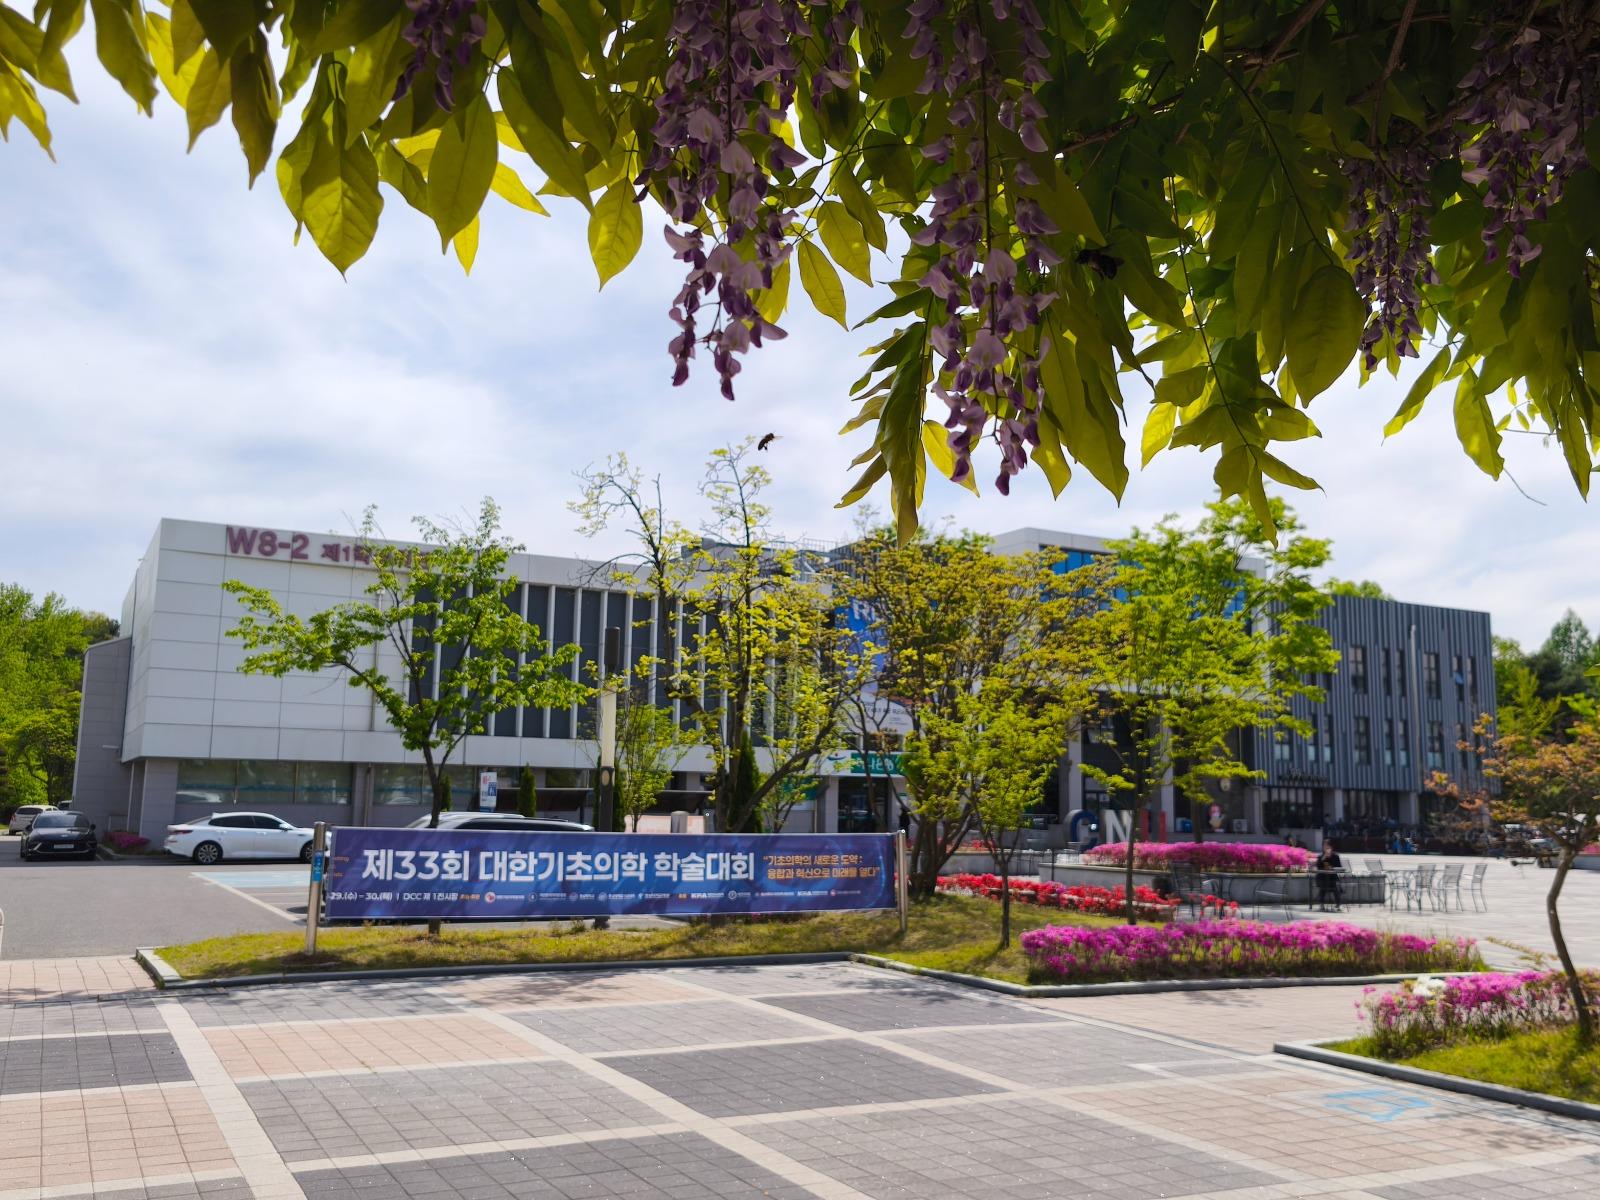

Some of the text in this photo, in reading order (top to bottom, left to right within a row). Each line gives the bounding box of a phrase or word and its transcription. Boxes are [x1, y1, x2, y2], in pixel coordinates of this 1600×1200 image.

[227, 525, 310, 560] W8-2
[362, 849, 755, 882] 제33회 대한기초의학 학술대회
[813, 855, 840, 865] 새로운
[767, 868, 794, 879] 융합과
[796, 867, 830, 879] 혁신으로
[832, 867, 858, 878] 미래를
